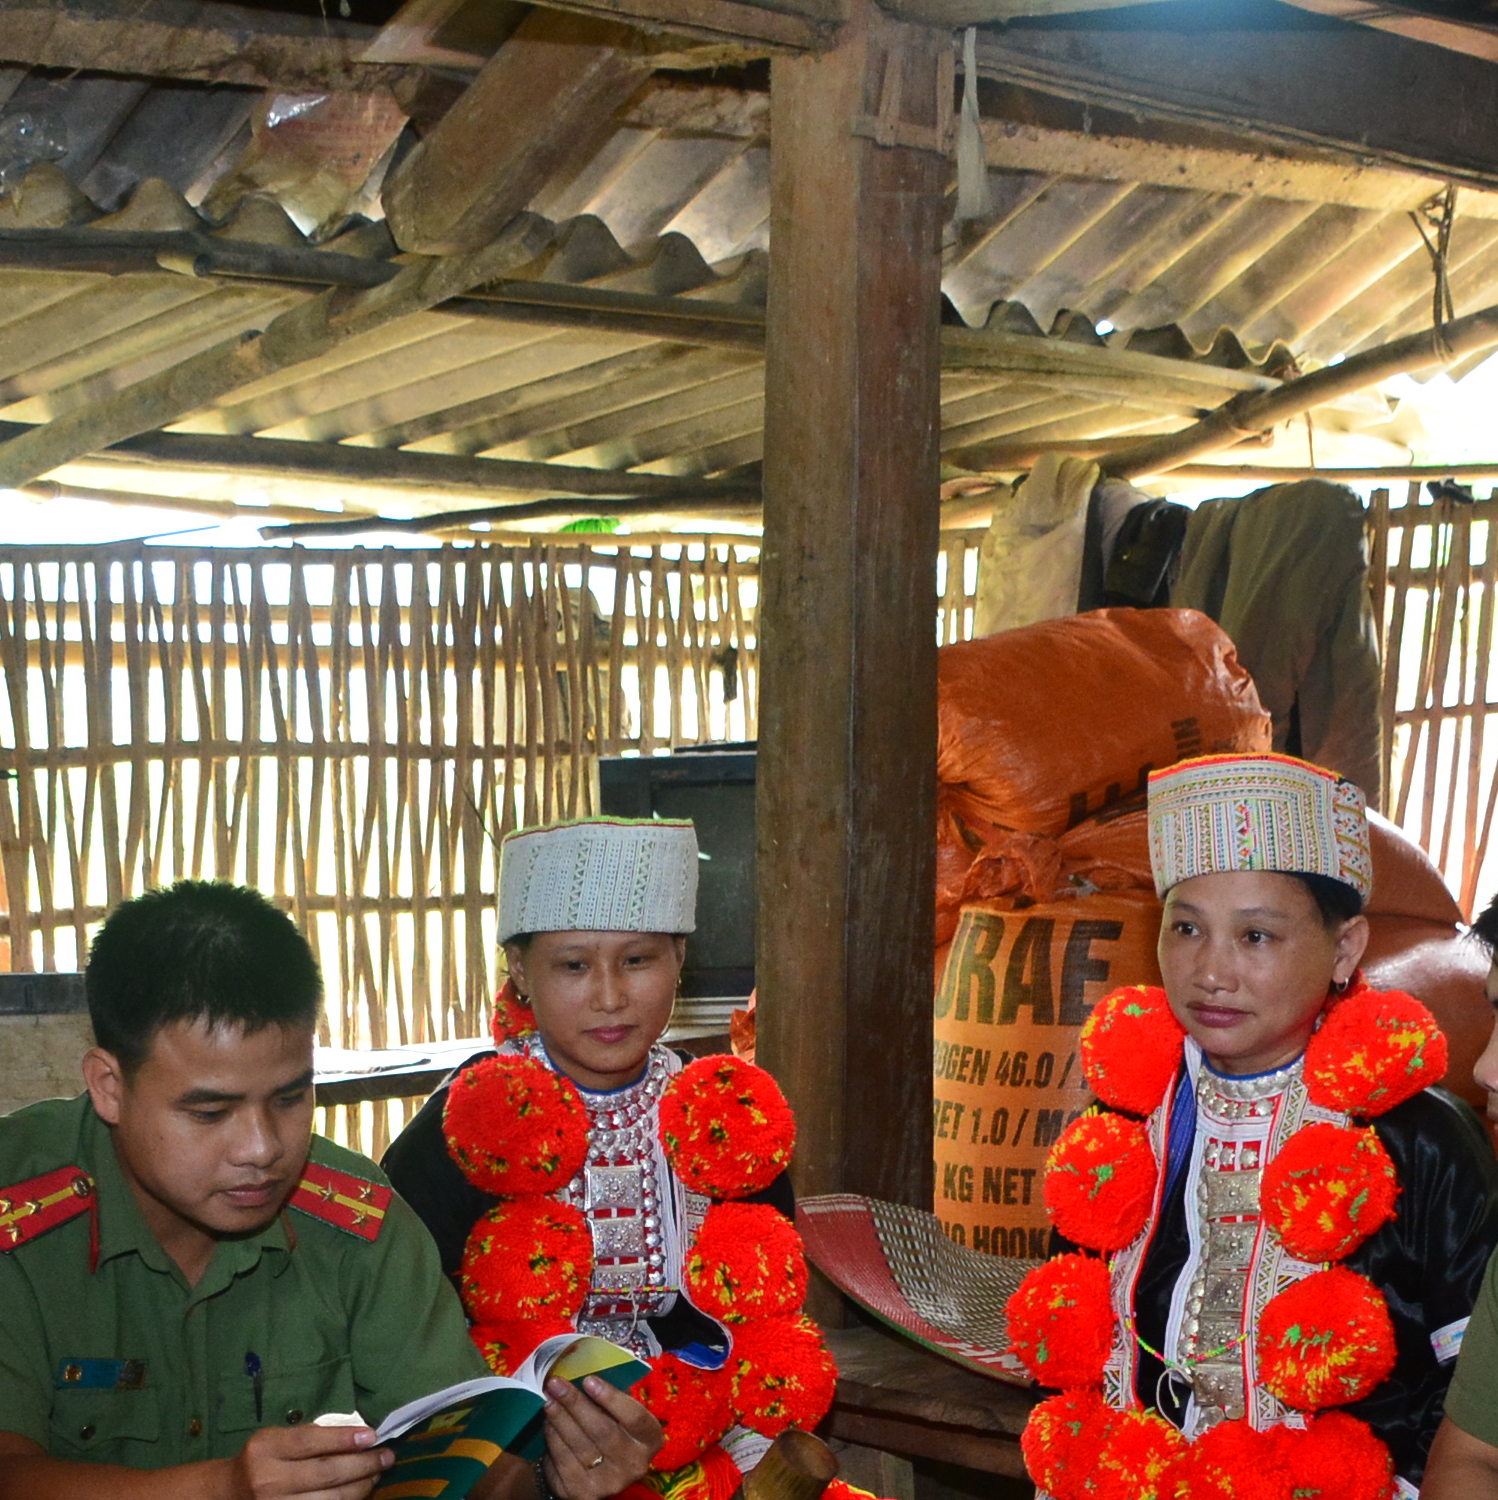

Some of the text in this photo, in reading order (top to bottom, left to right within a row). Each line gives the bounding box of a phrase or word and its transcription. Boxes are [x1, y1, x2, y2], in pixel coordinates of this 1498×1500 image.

[994, 1050, 1056, 1089] 46.0
[971, 1106, 1010, 1146] 1.0
[1011, 1107, 1030, 1148] /
[942, 1161, 974, 1203] KG
[981, 1165, 1038, 1206] NET
